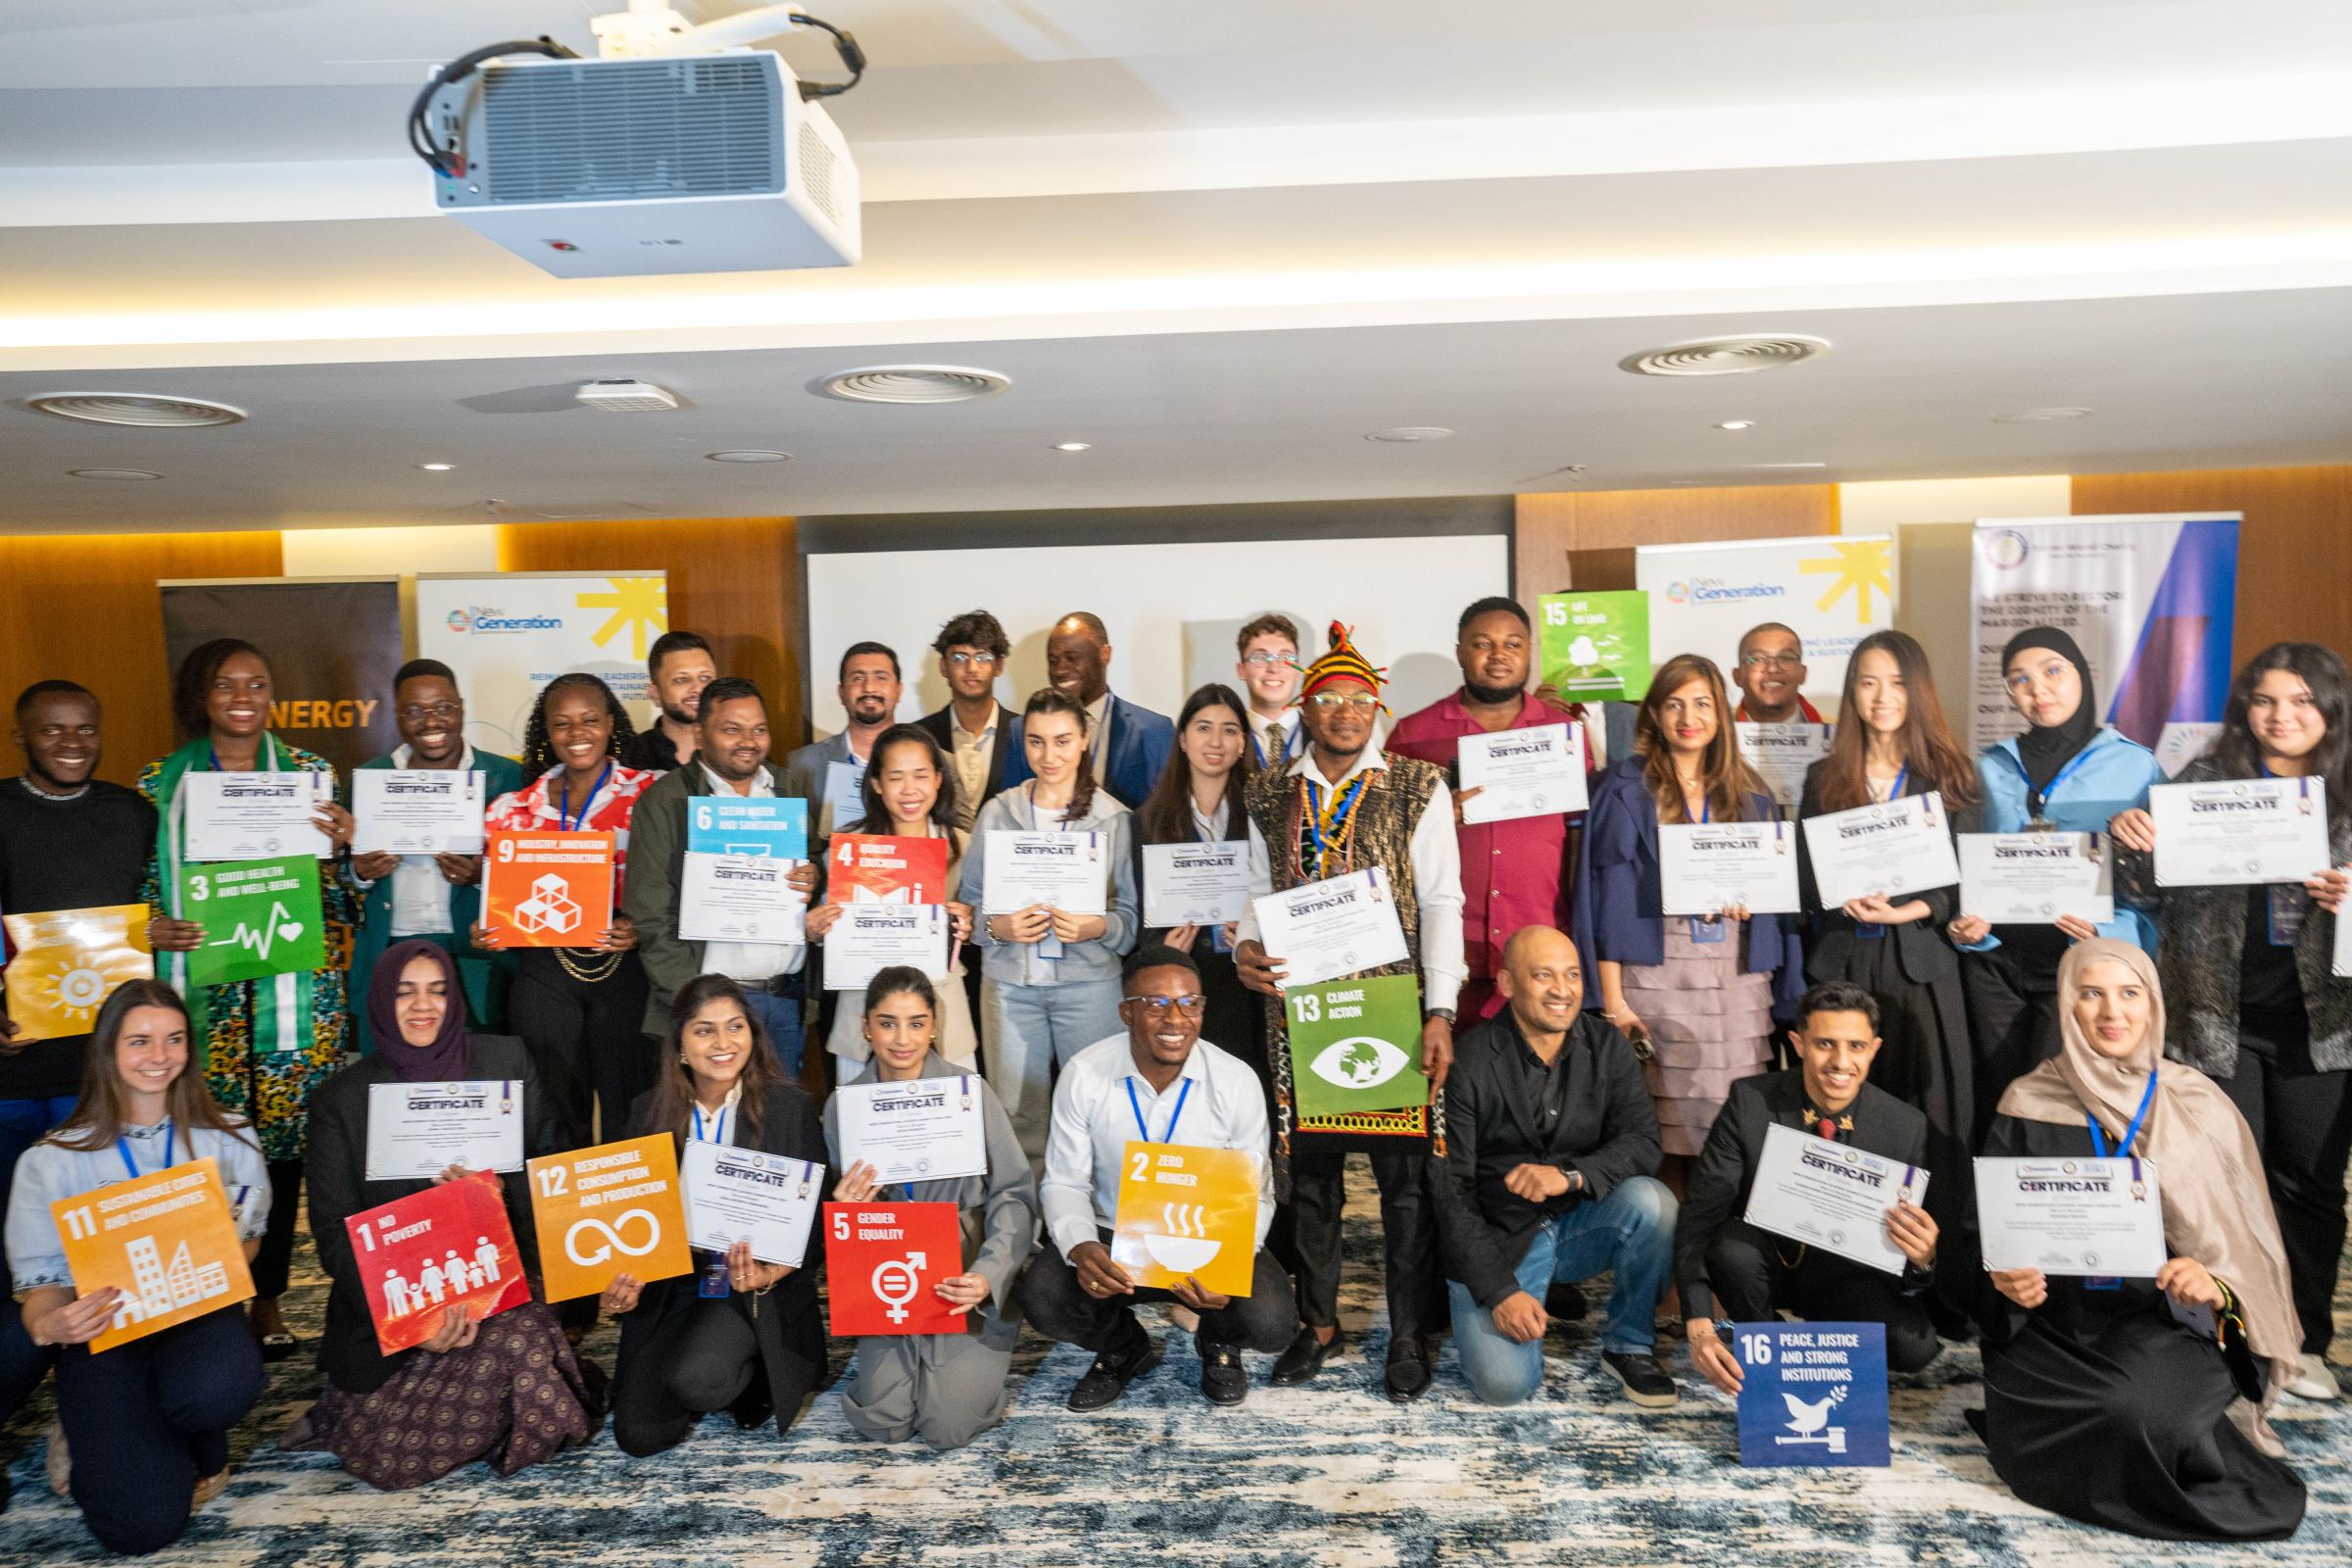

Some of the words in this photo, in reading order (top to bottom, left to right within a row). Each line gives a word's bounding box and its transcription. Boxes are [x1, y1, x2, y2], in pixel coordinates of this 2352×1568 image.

[1695, 583, 1785, 600] Generation
[476, 606, 504, 615] New
[1544, 603, 1567, 625] 15
[475, 615, 563, 629] Generation
[267, 699, 377, 728] NERGY
[221, 788, 295, 797] CERTIFICATE
[386, 785, 450, 794] CERTIFICATE
[2191, 799, 2280, 812] CERTIFICATE
[696, 806, 712, 830] 6
[718, 820, 737, 830] AND
[738, 821, 788, 831] SANITATION
[1840, 817, 1909, 838] CERTIFICATE
[498, 839, 514, 862] 9
[1014, 846, 1075, 855] CERTIFICATE
[1692, 840, 1760, 851] CERTIFICATE
[1994, 848, 2071, 858] CERTIFICATE
[837, 843, 854, 866] 4
[858, 858, 907, 869] EDUCATION
[1173, 858, 1235, 868] CERTIFICATE
[216, 871, 245, 883] GOOD
[245, 866, 285, 880] HEALTH
[714, 869, 777, 881] CERTIFICATE
[189, 875, 210, 901] 3
[217, 886, 240, 899] AND
[240, 878, 300, 895] WELL-BEING
[1290, 893, 1357, 917] CERTIFICATE
[856, 919, 916, 928] CERTIFICATE
[1326, 989, 1366, 1004] CLIMATE
[1292, 994, 1321, 1023] 13
[1328, 1005, 1362, 1020] ACTION
[408, 1100, 484, 1109] CERTIFICATE
[872, 1097, 945, 1112] CERTIFICATE
[574, 1150, 642, 1174] RESPONSIBLE
[1129, 1152, 1151, 1182] 2
[1157, 1153, 1184, 1168] ZERO
[576, 1166, 650, 1191] CONSUMPTION
[715, 1164, 784, 1188] CERTIFICATE
[1155, 1171, 1198, 1187] HUNGER
[1801, 1154, 1882, 1188] CERTIFICATE
[536, 1165, 569, 1198] 12
[2019, 1181, 2111, 1193] CERTIFICATE
[98, 1181, 173, 1213] SUSTAINABLE
[172, 1171, 208, 1191] CITIES
[580, 1193, 602, 1207] AND
[603, 1179, 667, 1203] PRODUCTION
[104, 1213, 130, 1231] AND
[129, 1189, 207, 1223] COMMUNITIES
[858, 1212, 896, 1224] GENDER
[62, 1205, 97, 1241] 11
[377, 1214, 396, 1230] NO
[833, 1212, 851, 1241] 5
[356, 1222, 376, 1252] 1
[382, 1218, 432, 1246] POVERTY
[858, 1229, 905, 1242] EQUALITY
[1779, 1334, 1816, 1348] PEACE,
[1817, 1334, 1860, 1348] JUSTICE
[1740, 1334, 1772, 1365] 16
[1781, 1350, 1803, 1364] AND
[1804, 1350, 1848, 1364] STRONG
[1781, 1368, 1853, 1382] INSTITUTIONS
